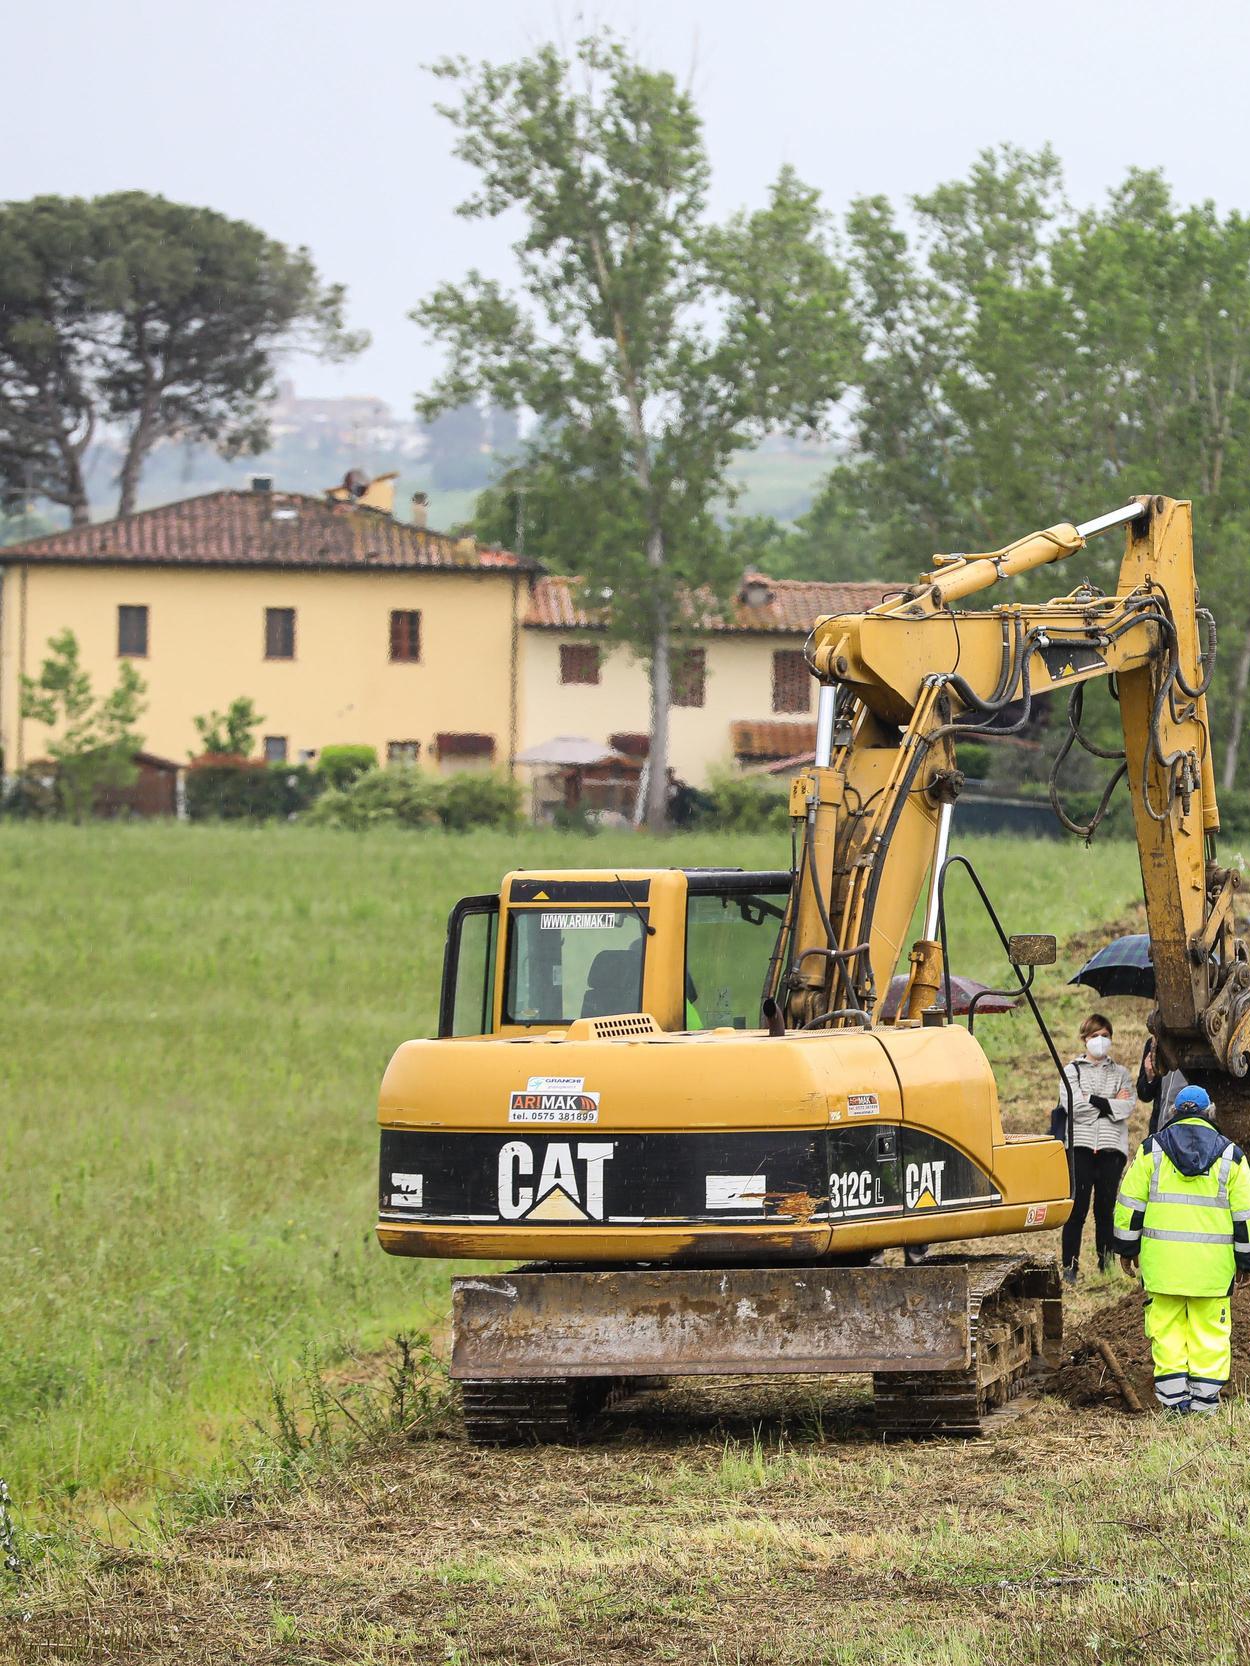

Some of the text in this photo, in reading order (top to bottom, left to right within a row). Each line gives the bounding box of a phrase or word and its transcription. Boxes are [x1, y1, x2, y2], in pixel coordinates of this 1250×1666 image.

[542, 914, 614, 928] WWW.ARIMAK.IT
[513, 1096, 577, 1109] ARIMAK
[513, 1112, 595, 1121] tel. 0575 381899
[498, 1141, 614, 1220] CAT
[829, 1170, 872, 1208] 312C
[906, 1161, 945, 1208] CAT
